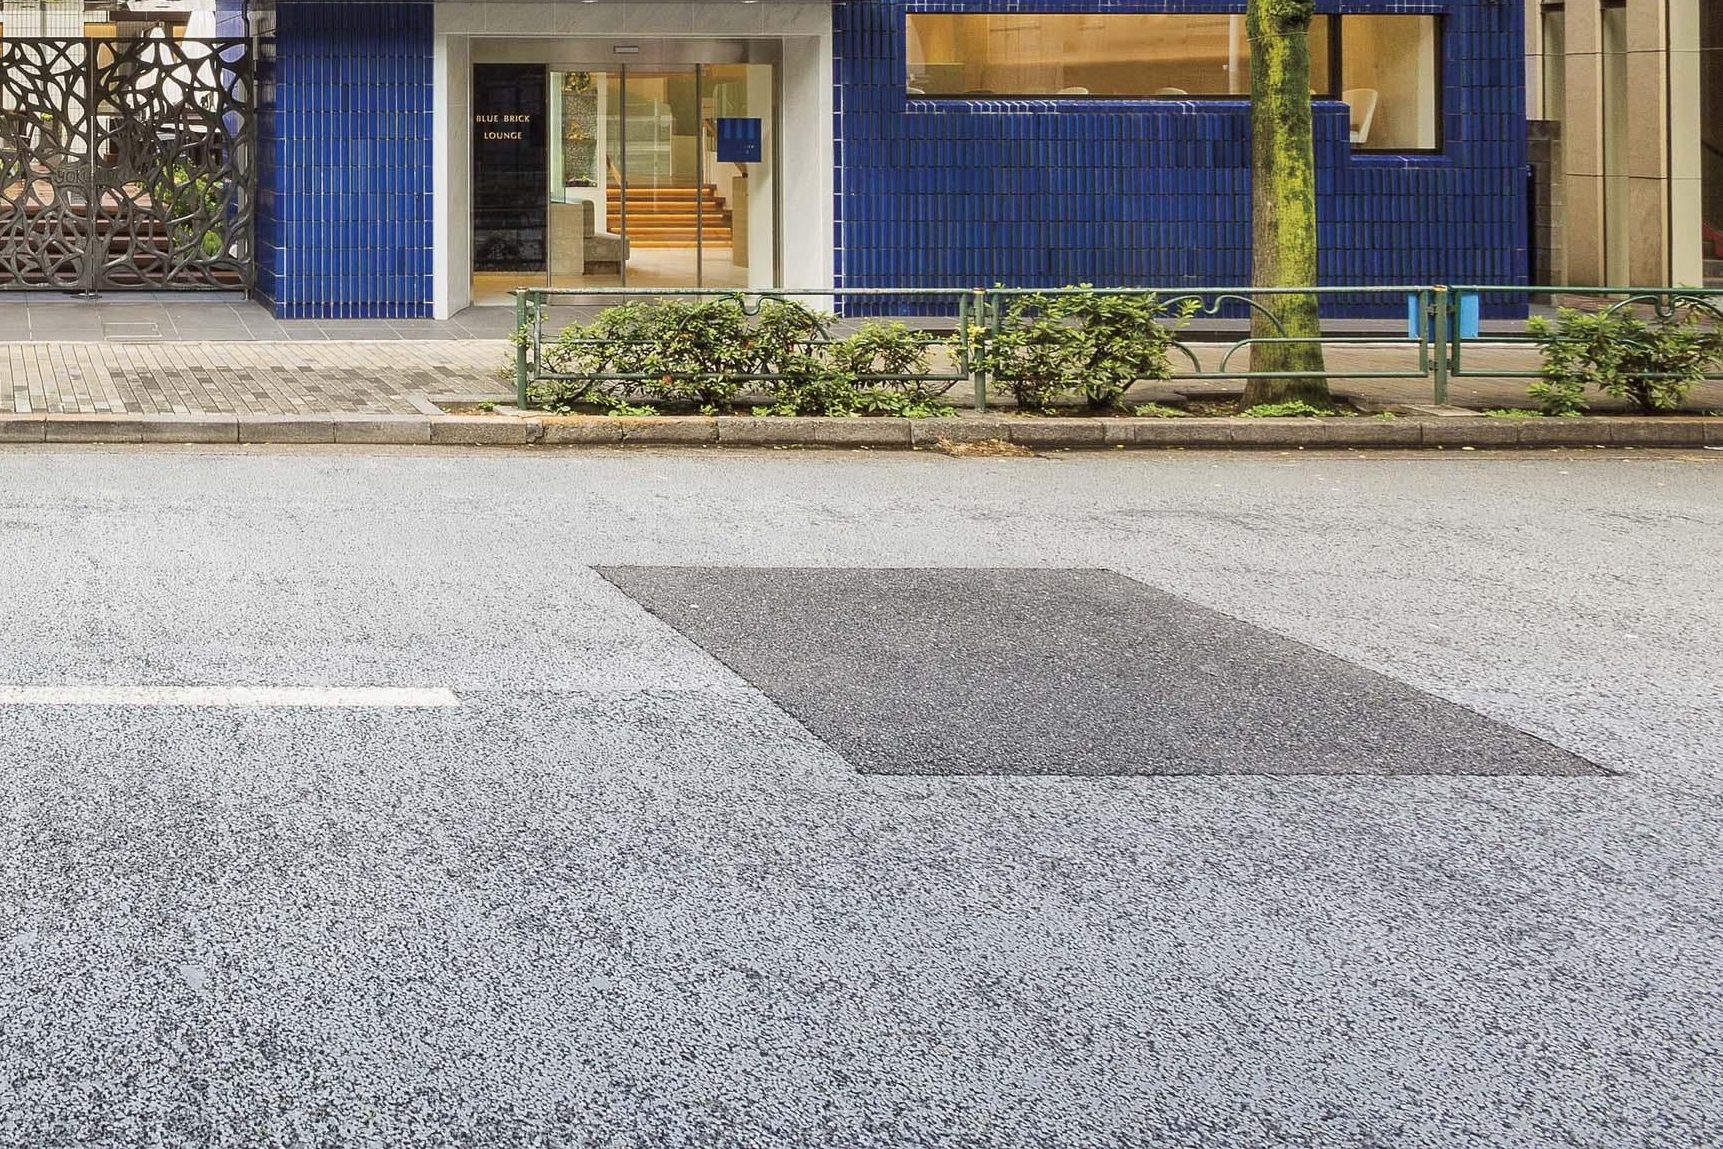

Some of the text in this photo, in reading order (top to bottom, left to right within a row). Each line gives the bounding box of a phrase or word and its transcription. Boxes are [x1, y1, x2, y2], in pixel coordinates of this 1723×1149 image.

[476, 114, 530, 123] BLUE BRICK
[484, 131, 523, 140] LOUNGE
